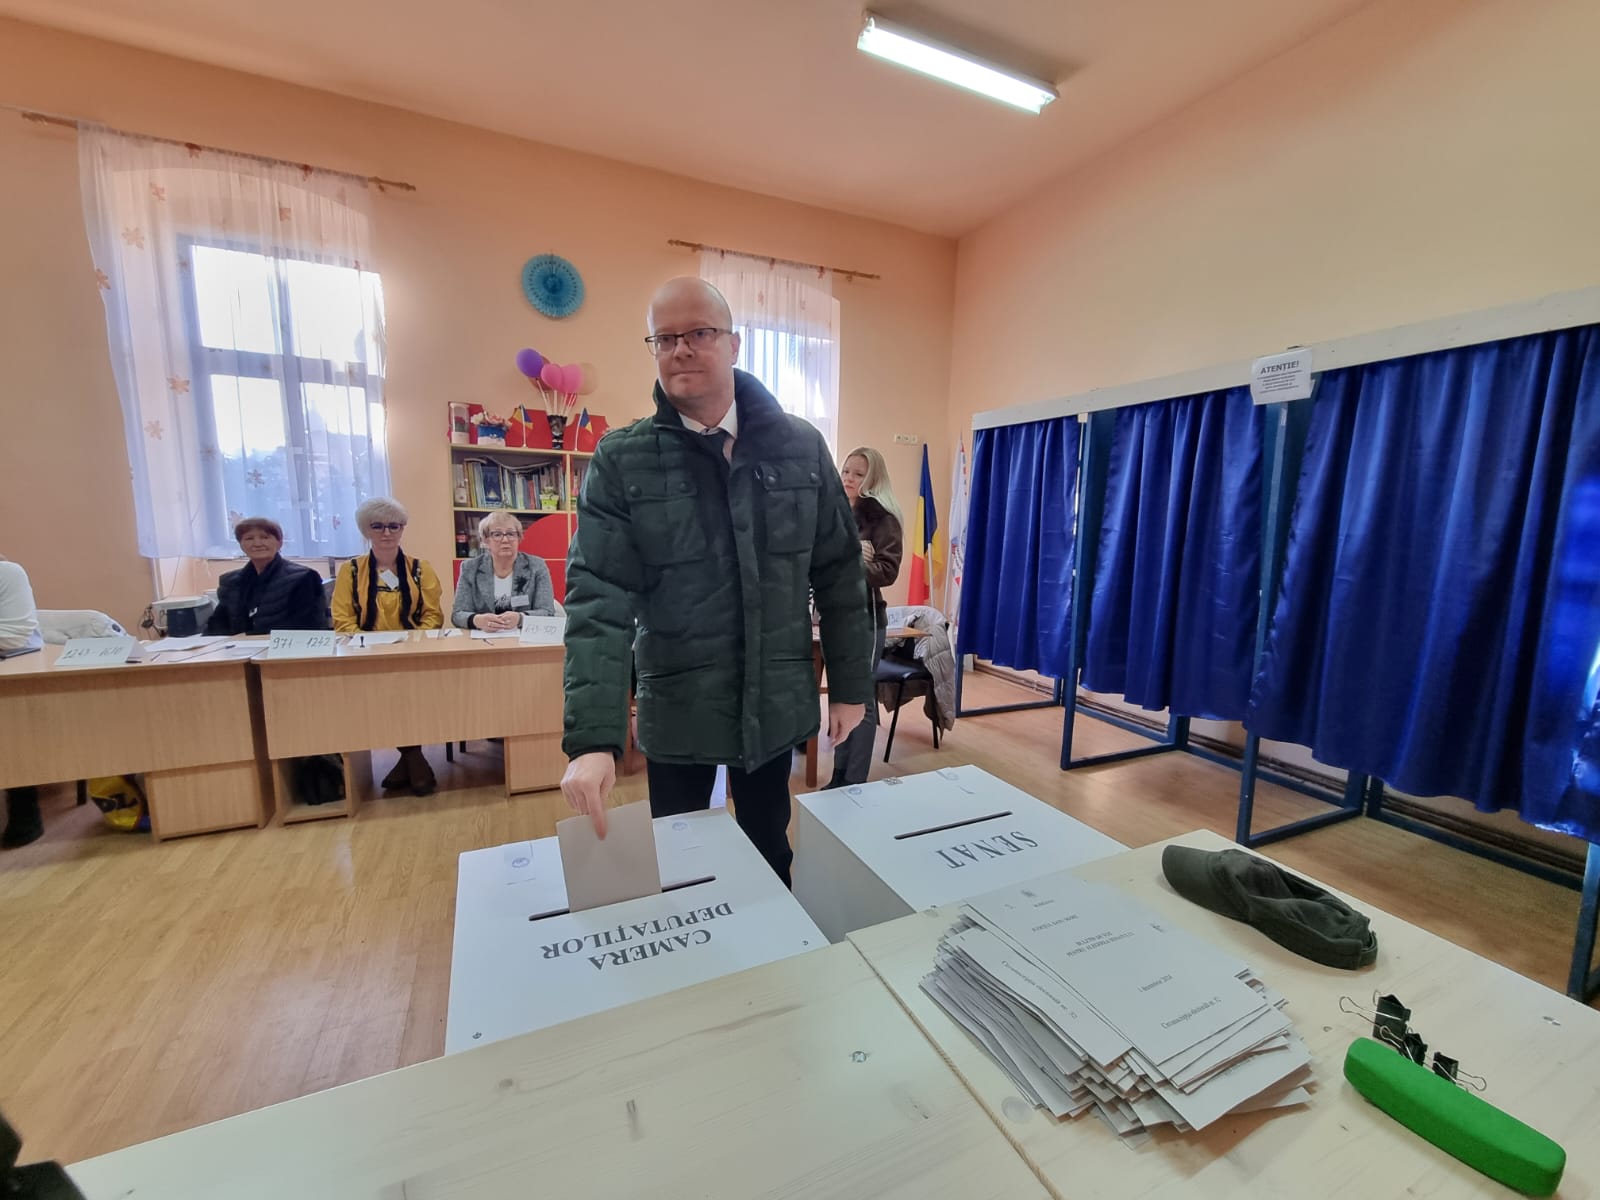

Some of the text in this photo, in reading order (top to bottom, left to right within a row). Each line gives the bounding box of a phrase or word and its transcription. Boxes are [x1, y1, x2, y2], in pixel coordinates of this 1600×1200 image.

[933, 831, 1039, 870] SENAT
[540, 902, 735, 959] DEPUTAȚILOR
[588, 929, 712, 970] CAMERA
